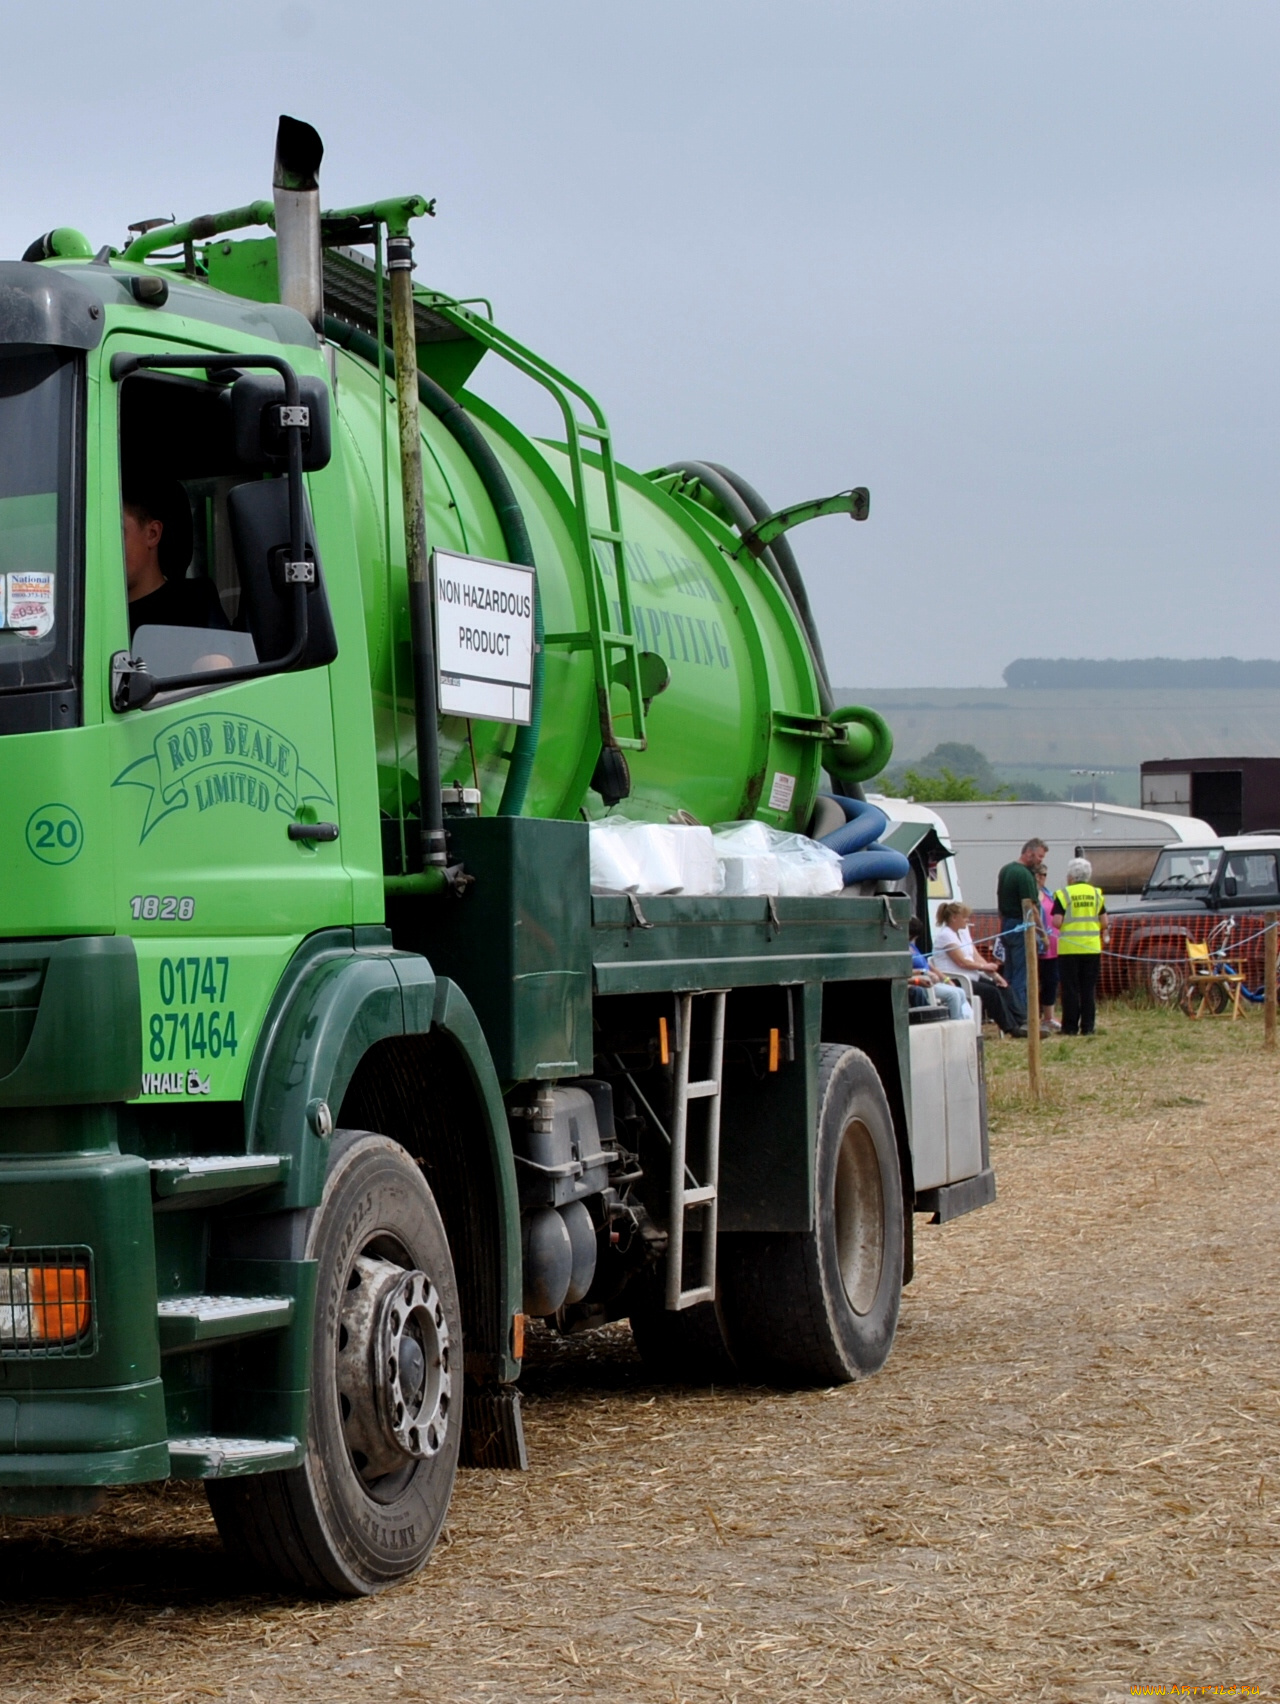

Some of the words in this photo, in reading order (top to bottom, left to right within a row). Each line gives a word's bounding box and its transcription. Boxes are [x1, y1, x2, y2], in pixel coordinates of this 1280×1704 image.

[12, 575, 50, 583] National
[439, 578, 461, 605] NON
[463, 583, 531, 619] HAZARDOUS
[459, 626, 511, 657] PRODUCT
[167, 722, 213, 772] ROB
[223, 720, 290, 778] BEALE
[195, 771, 270, 813] LIMITED
[35, 819, 78, 848] 20
[129, 895, 196, 921] 1828
[159, 957, 229, 1006] 01747
[149, 1011, 238, 1062] 871464
